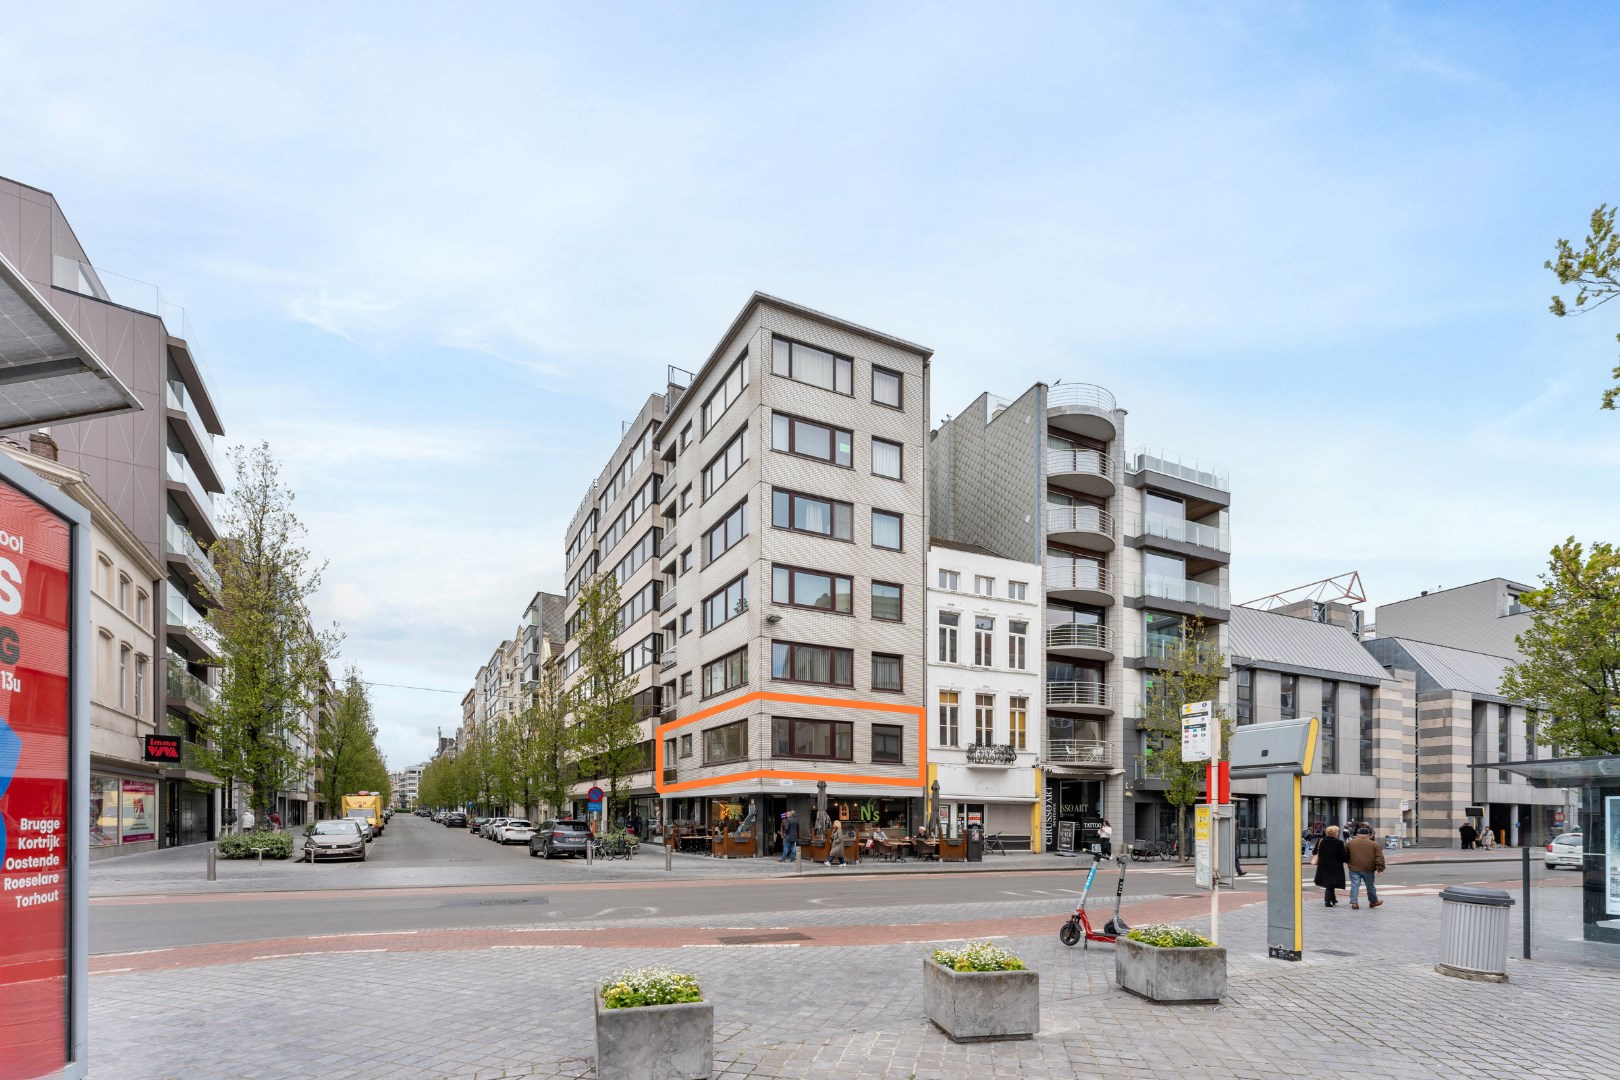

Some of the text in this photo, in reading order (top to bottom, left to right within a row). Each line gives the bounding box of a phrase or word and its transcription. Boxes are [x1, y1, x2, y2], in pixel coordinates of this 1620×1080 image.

[20, 818, 60, 834] Brugge
[18, 834, 60, 851] Kortrijk
[6, 854, 60, 870] Oostende
[4, 873, 59, 890] Roeselare
[15, 890, 59, 908] Torhout
